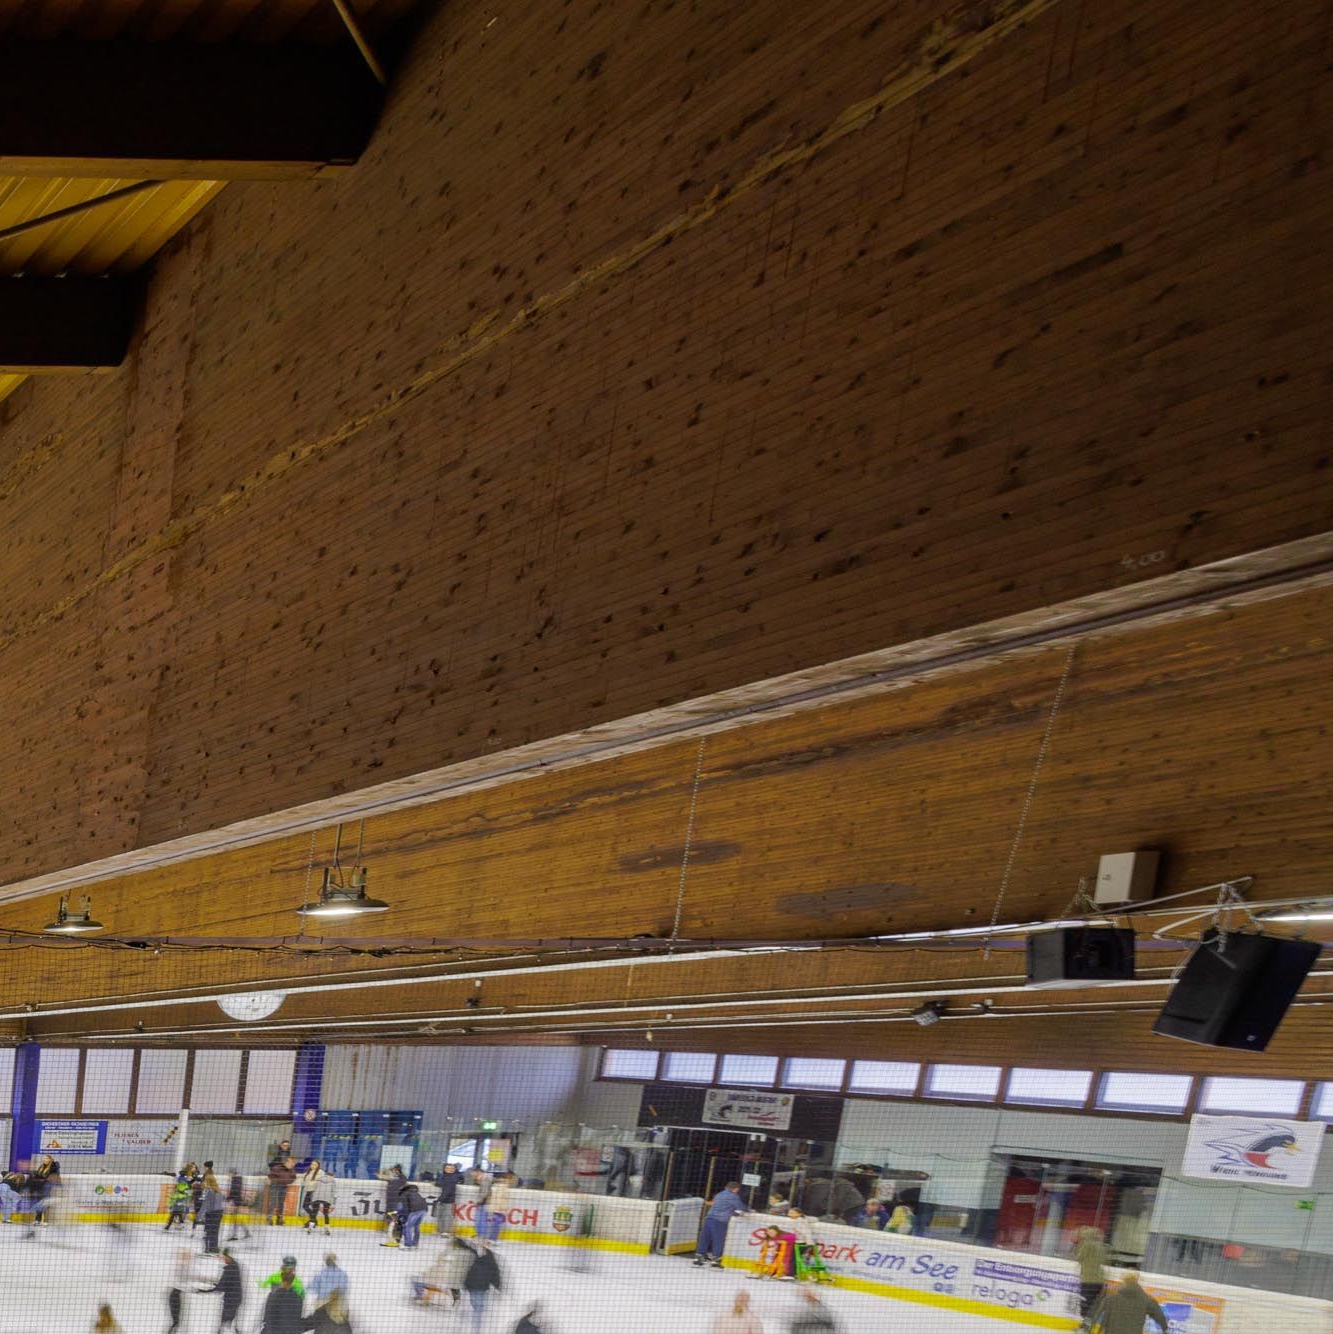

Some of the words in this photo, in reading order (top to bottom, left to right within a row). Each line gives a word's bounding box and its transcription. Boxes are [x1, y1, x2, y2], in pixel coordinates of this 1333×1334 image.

[453, 1200, 540, 1227] KÖSCH
[866, 1251, 906, 1271] am
[911, 1254, 959, 1280] See
[971, 1280, 1034, 1308] reloga
